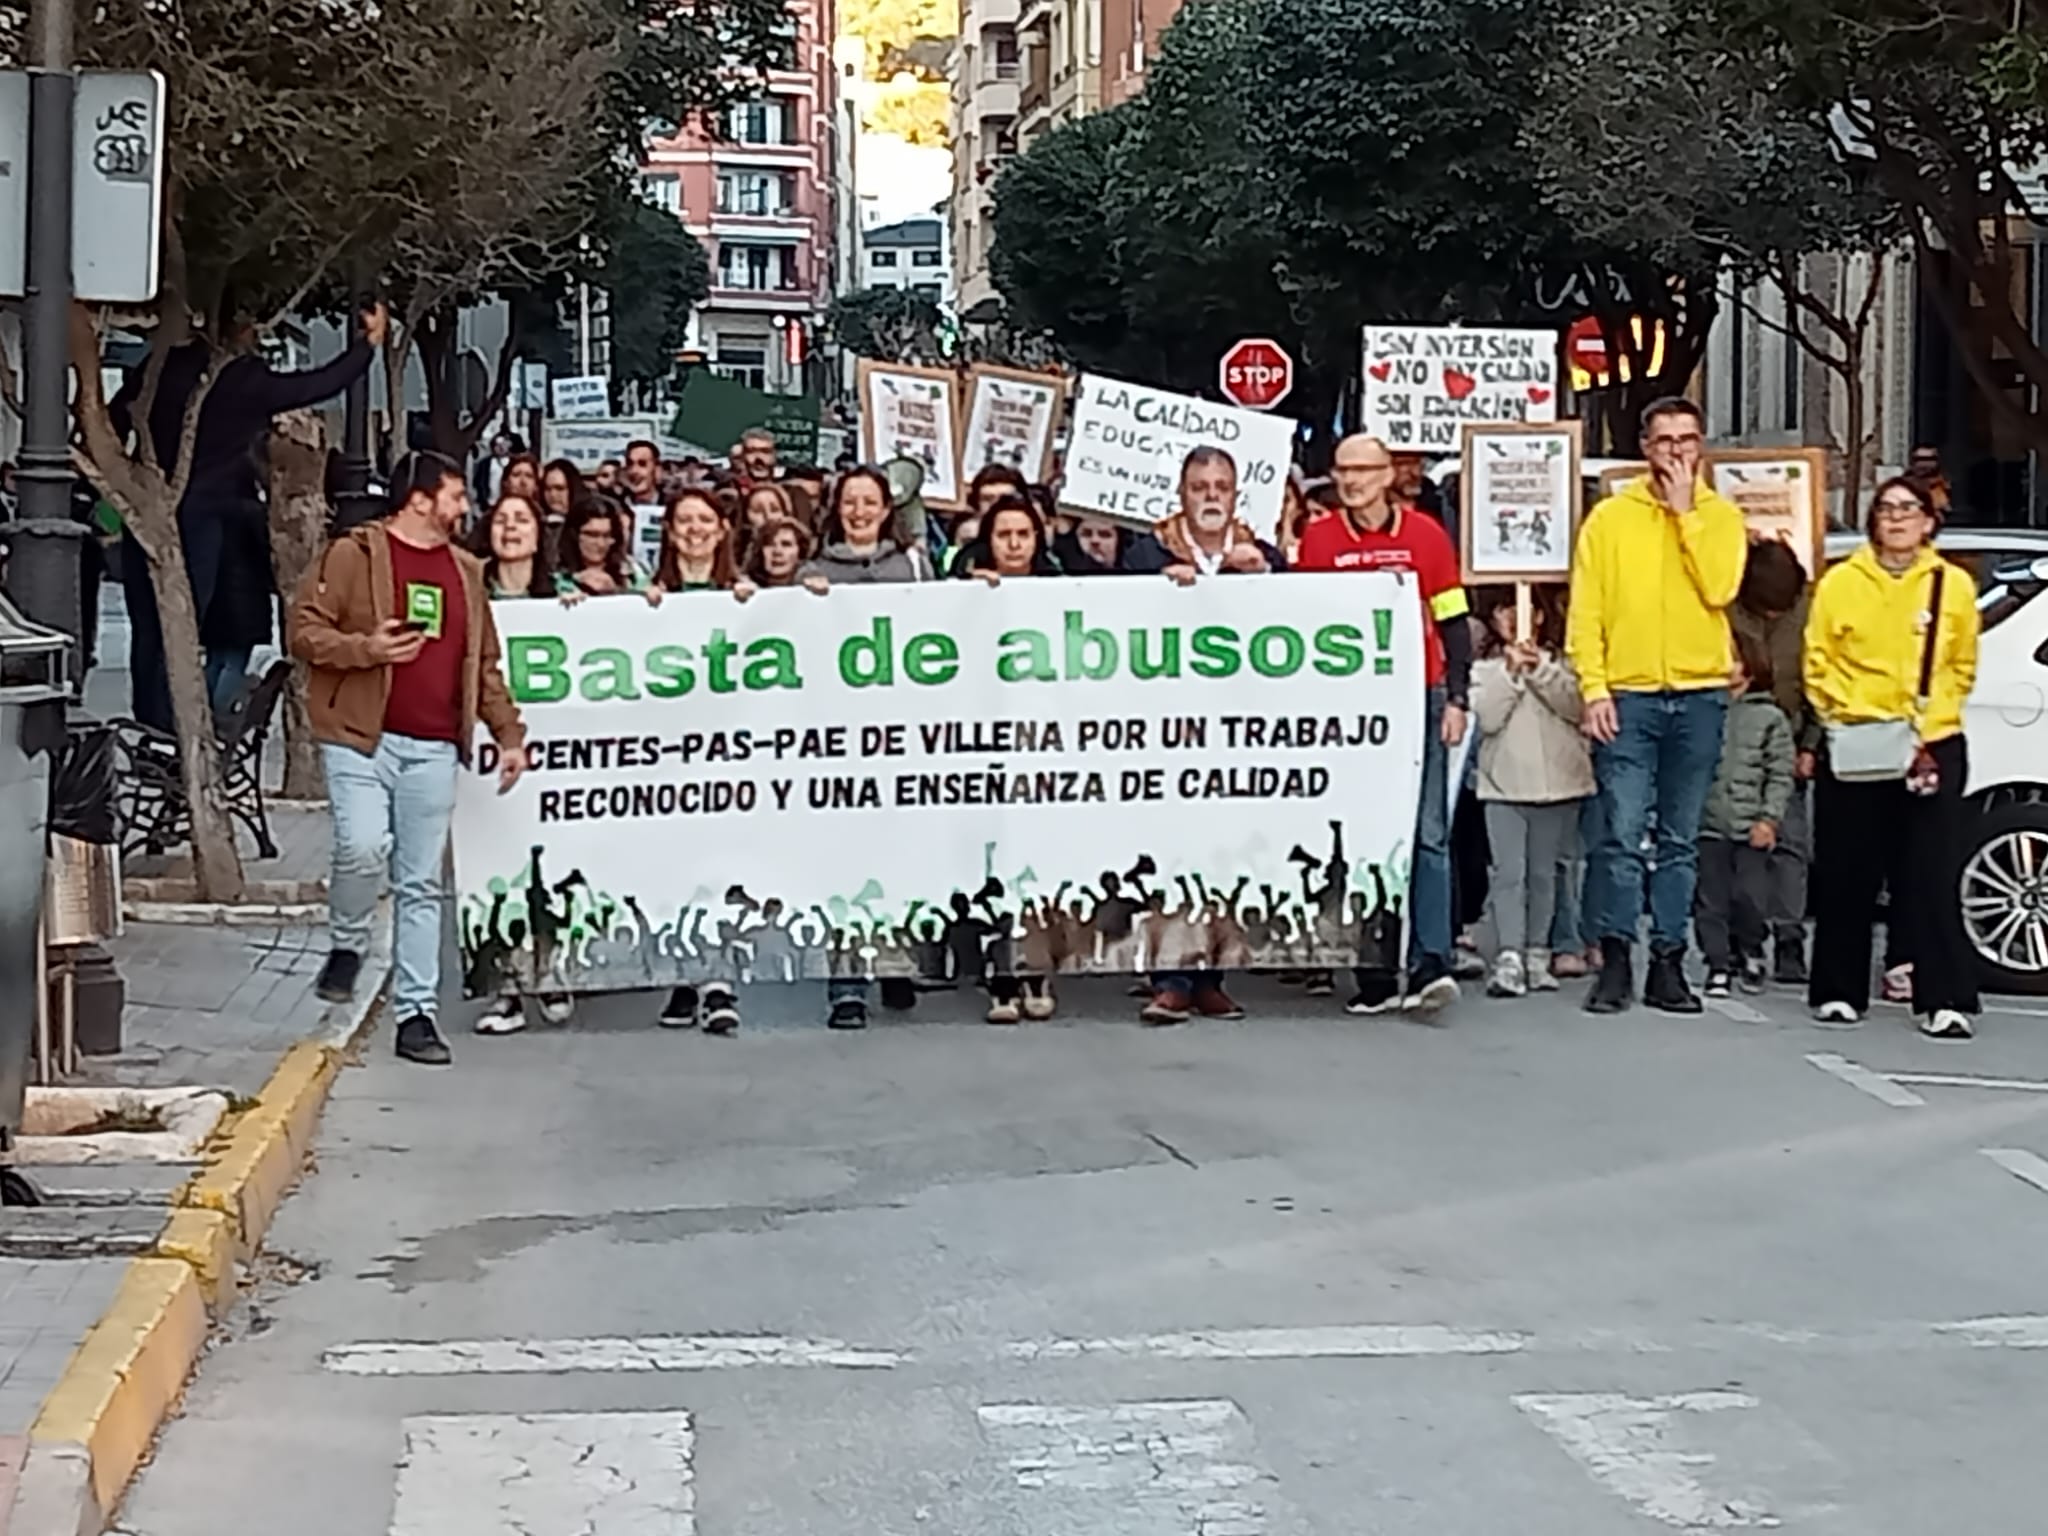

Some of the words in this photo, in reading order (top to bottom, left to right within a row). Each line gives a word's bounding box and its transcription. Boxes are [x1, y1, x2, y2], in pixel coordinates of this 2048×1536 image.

[1228, 365, 1286, 385] STOP
[1393, 359, 1428, 385] NO
[1096, 388, 1130, 410] LA
[1134, 397, 1241, 441] CALIDAD
[1389, 420, 1412, 443] NO
[1084, 420, 1190, 464] EDUCAT
[507, 627, 802, 703] Basta
[838, 615, 959, 687] de
[997, 608, 1394, 683] abusos!
[478, 726, 847, 776] DCENTES-PAS-PAE
[860, 725, 906, 757] DE
[920, 720, 1064, 754] VILLENA
[1078, 719, 1146, 752] POR
[1161, 716, 1207, 749] UN
[1220, 715, 1390, 749] TRABAJO
[540, 780, 756, 822] RECONOCIDO
[771, 779, 793, 810] Y
[808, 778, 882, 809] UNA
[896, 763, 1106, 806] ENSEÑANZA
[1120, 769, 1165, 800] DE
[1178, 767, 1330, 799] CALIDAD
